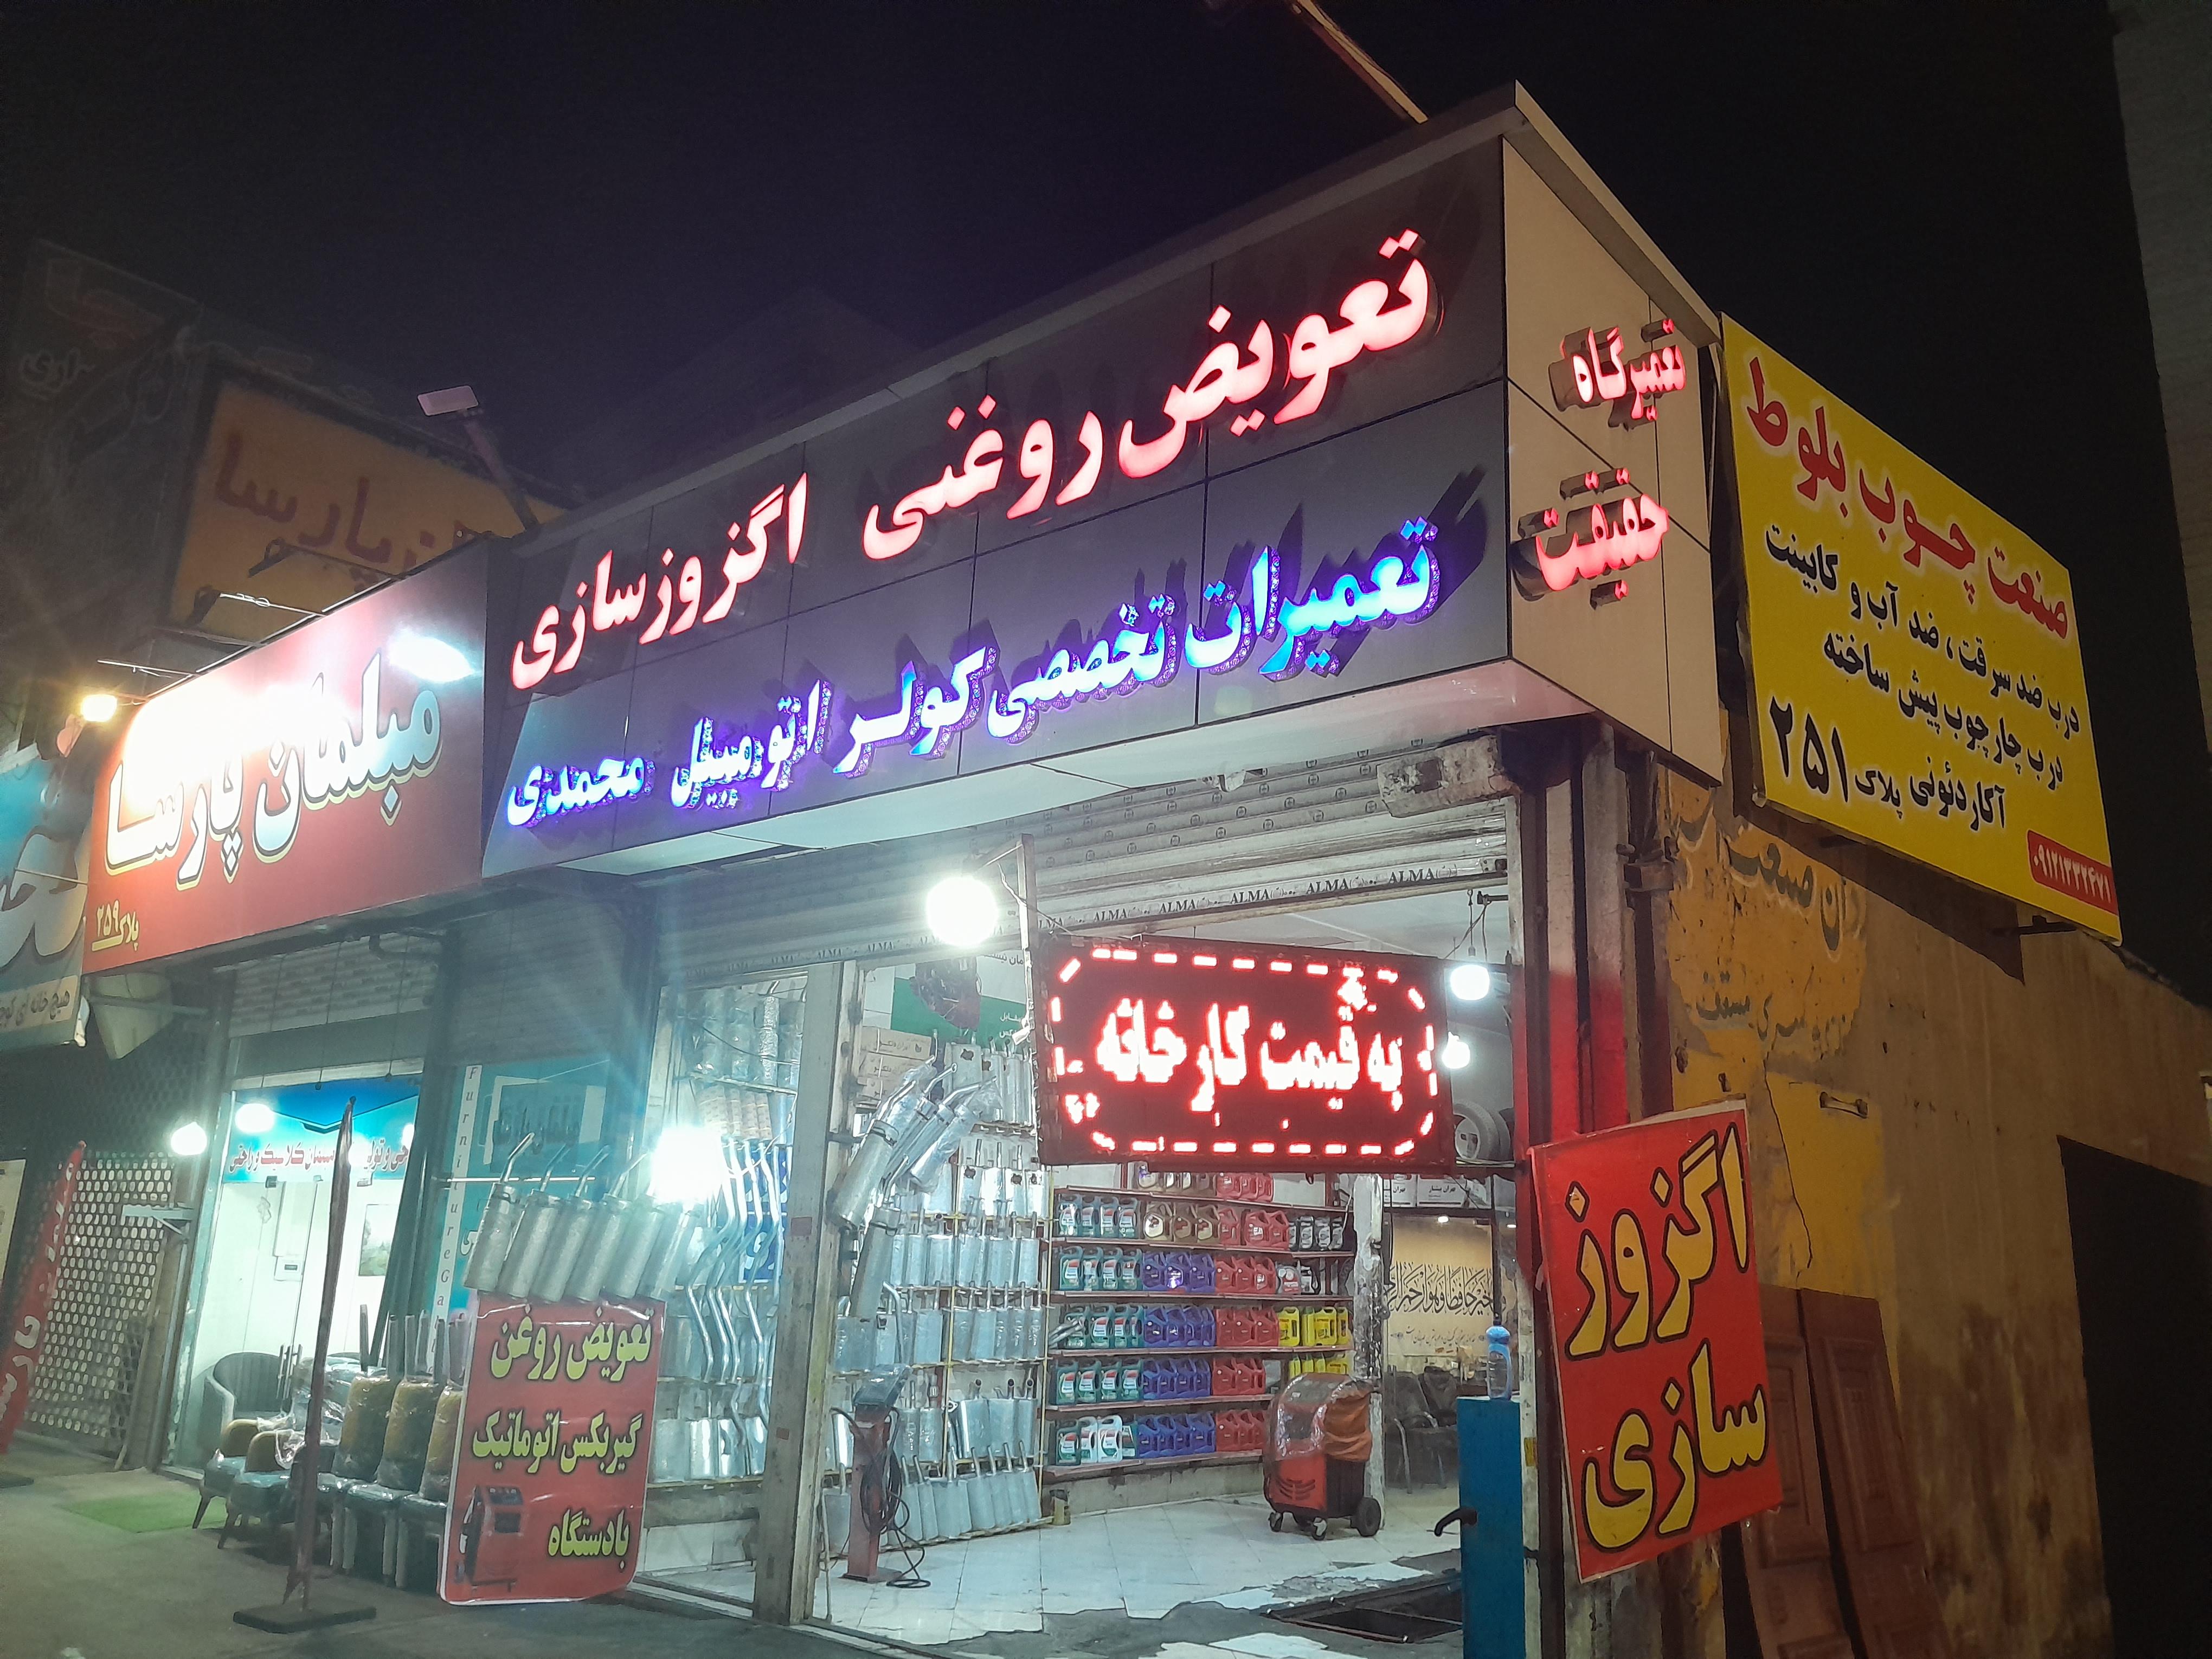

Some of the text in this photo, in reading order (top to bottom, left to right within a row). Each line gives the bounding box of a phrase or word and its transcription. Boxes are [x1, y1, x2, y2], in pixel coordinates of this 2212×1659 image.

[1118, 228, 1430, 478] تعویض
[1568, 318, 1686, 419] تعمیرگاه
[863, 394, 1103, 560] روغنی
[1747, 357, 2068, 640] صنعت چوب بلوط
[1535, 467, 1669, 592] حقیقت
[1766, 525, 1838, 593] کابینت
[1851, 582, 1861, 620] و
[1867, 581, 1898, 629] آب
[1909, 611, 1939, 648] ضد
[507, 515, 1439, 827] تعمیرات تخصصی کولر اتومبیل محمدی
[1823, 633, 1889, 692] ساخته
[2016, 674, 2042, 709] ضد
[1899, 670, 1940, 735] پیش
[2048, 698, 2080, 740] درب
[253, 651, 443, 863] مبلمان
[1770, 696, 1848, 803] ۲۵۱
[2027, 748, 2062, 790] درب
[1855, 770, 1903, 819] پلاک
[96, 899, 119, 937] ۲۵۹
[1093, 908, 1128, 922] ALMA
[1159, 898, 1196, 914] ALMA
[1231, 888, 1269, 904] ALMA
[1306, 877, 1349, 895] ALMA
[1388, 867, 1437, 884] ALMA
[1260, 1004, 1360, 1111] قیمت
[1367, 1031, 1403, 1113] به
[1565, 1121, 1750, 1361] اگزوز
[491, 1303, 654, 1382] تعویض روغن
[472, 1410, 642, 1475] گیربکس اتوماتیک
[1582, 1338, 1769, 1552] سازی
